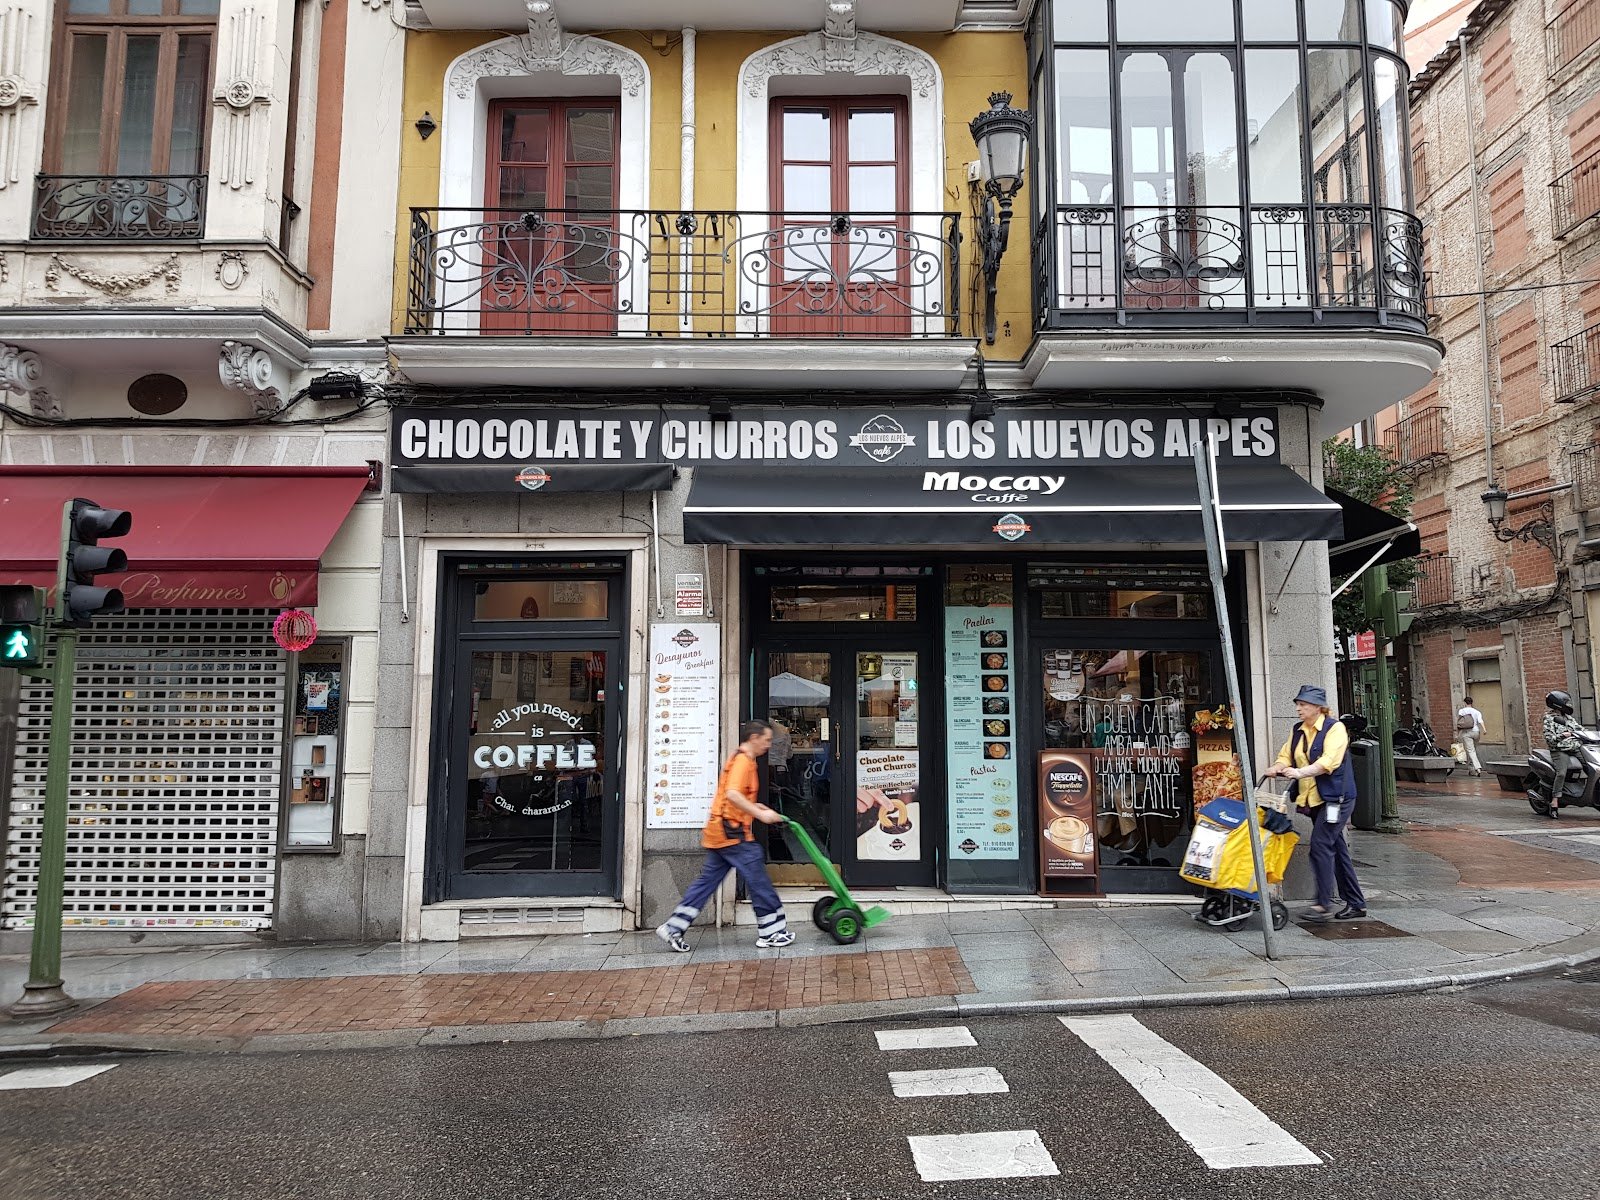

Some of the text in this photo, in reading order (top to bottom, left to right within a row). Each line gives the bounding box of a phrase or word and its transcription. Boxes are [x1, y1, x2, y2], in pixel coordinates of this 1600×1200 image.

[401, 418, 839, 460] CHOCOLATE Y CHURROS
[869, 434, 890, 442] NUEVOS
[890, 434, 906, 442] ALPES
[927, 419, 996, 459] LOS
[1007, 418, 1155, 460] NUEVOS
[873, 445, 892, 458] café
[922, 471, 1066, 495] Mocay
[119, 572, 249, 602] Perfumes
[963, 615, 995, 629] Paellas
[654, 650, 702, 665] Desayunos
[493, 709, 512, 729] all
[511, 702, 540, 721] you
[1078, 704, 1097, 734] UN
[1103, 704, 1137, 734] BUEN
[531, 724, 544, 738] is
[1199, 743, 1231, 752] PIZZAS
[473, 744, 598, 769] COFFEE
[859, 754, 905, 766] Chocolate
[1102, 757, 1113, 773] LA
[1115, 757, 1134, 774] HACE
[1136, 757, 1161, 774] MUCHO
[1163, 754, 1180, 774] MÁS
[883, 762, 917, 771] Churros
[970, 764, 997, 776] Pastas
